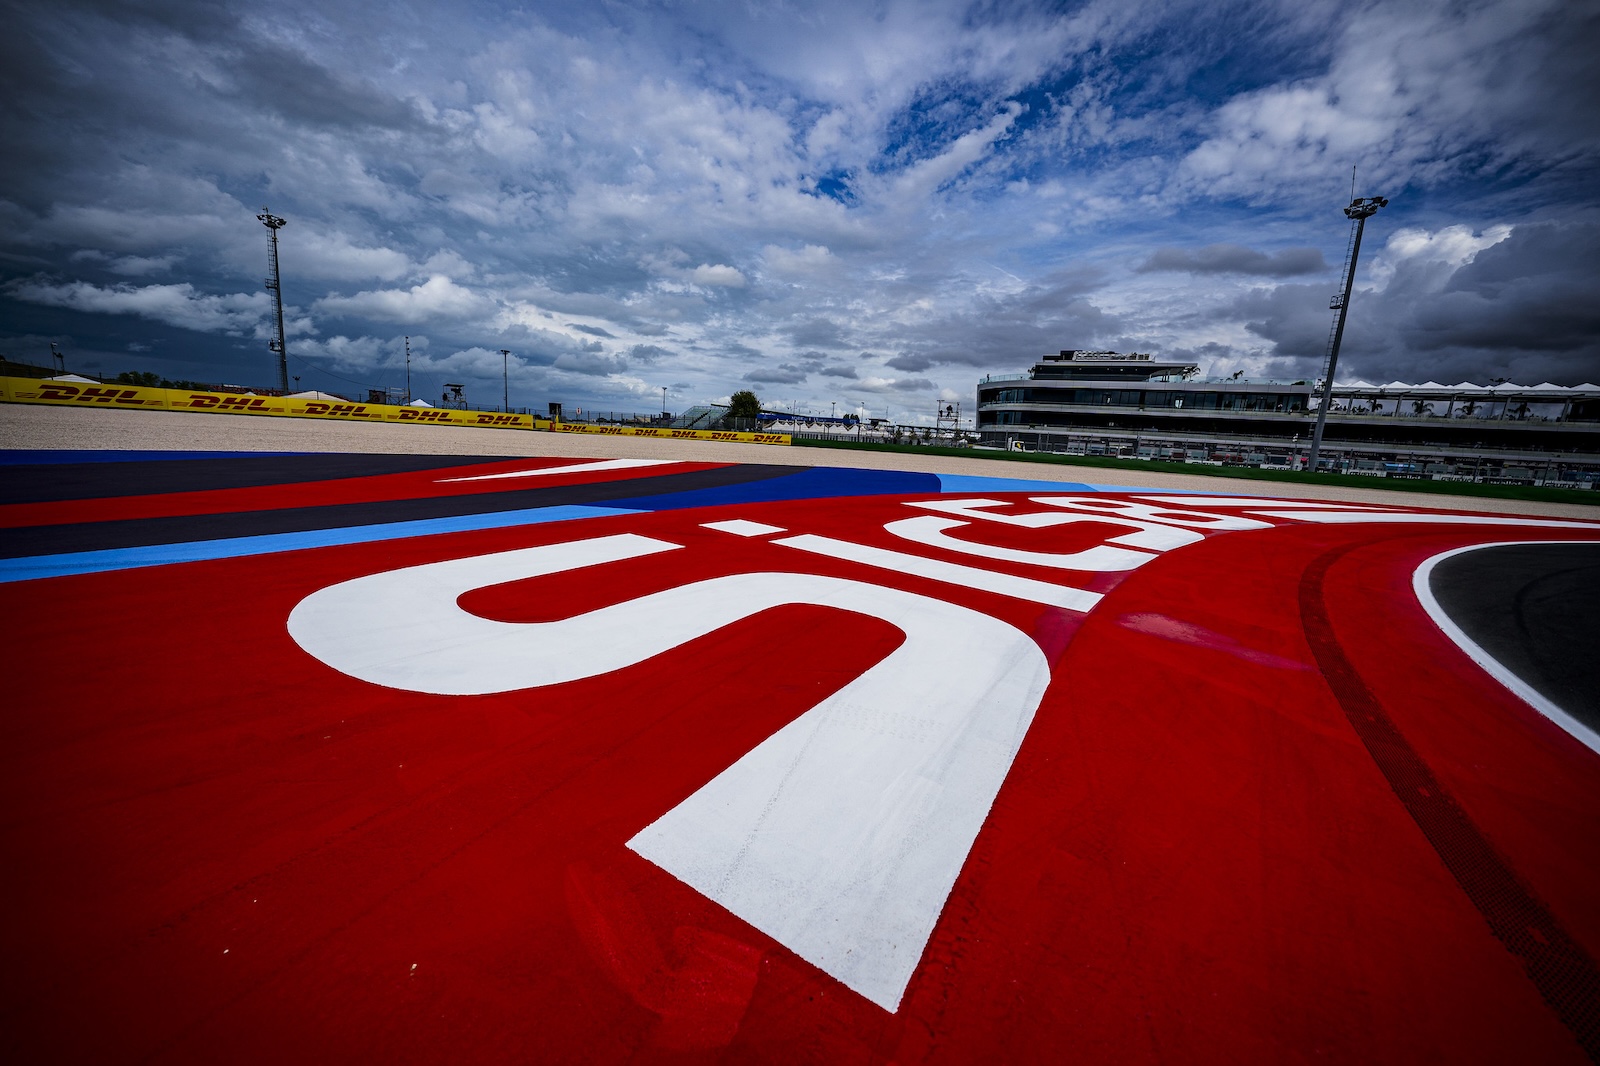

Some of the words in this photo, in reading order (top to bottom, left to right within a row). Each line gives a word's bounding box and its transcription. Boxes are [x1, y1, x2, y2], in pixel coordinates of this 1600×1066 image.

[39, 385, 145, 405] DHL
[188, 395, 270, 412] DHL
[304, 403, 371, 418] DHL
[399, 409, 453, 422] DHL
[476, 415, 523, 426] DHL
[562, 425, 588, 433] DHL
[599, 427, 622, 435] DHL
[634, 429, 659, 437] DHL
[711, 432, 739, 440] DHL
[752, 434, 783, 443] DHL
